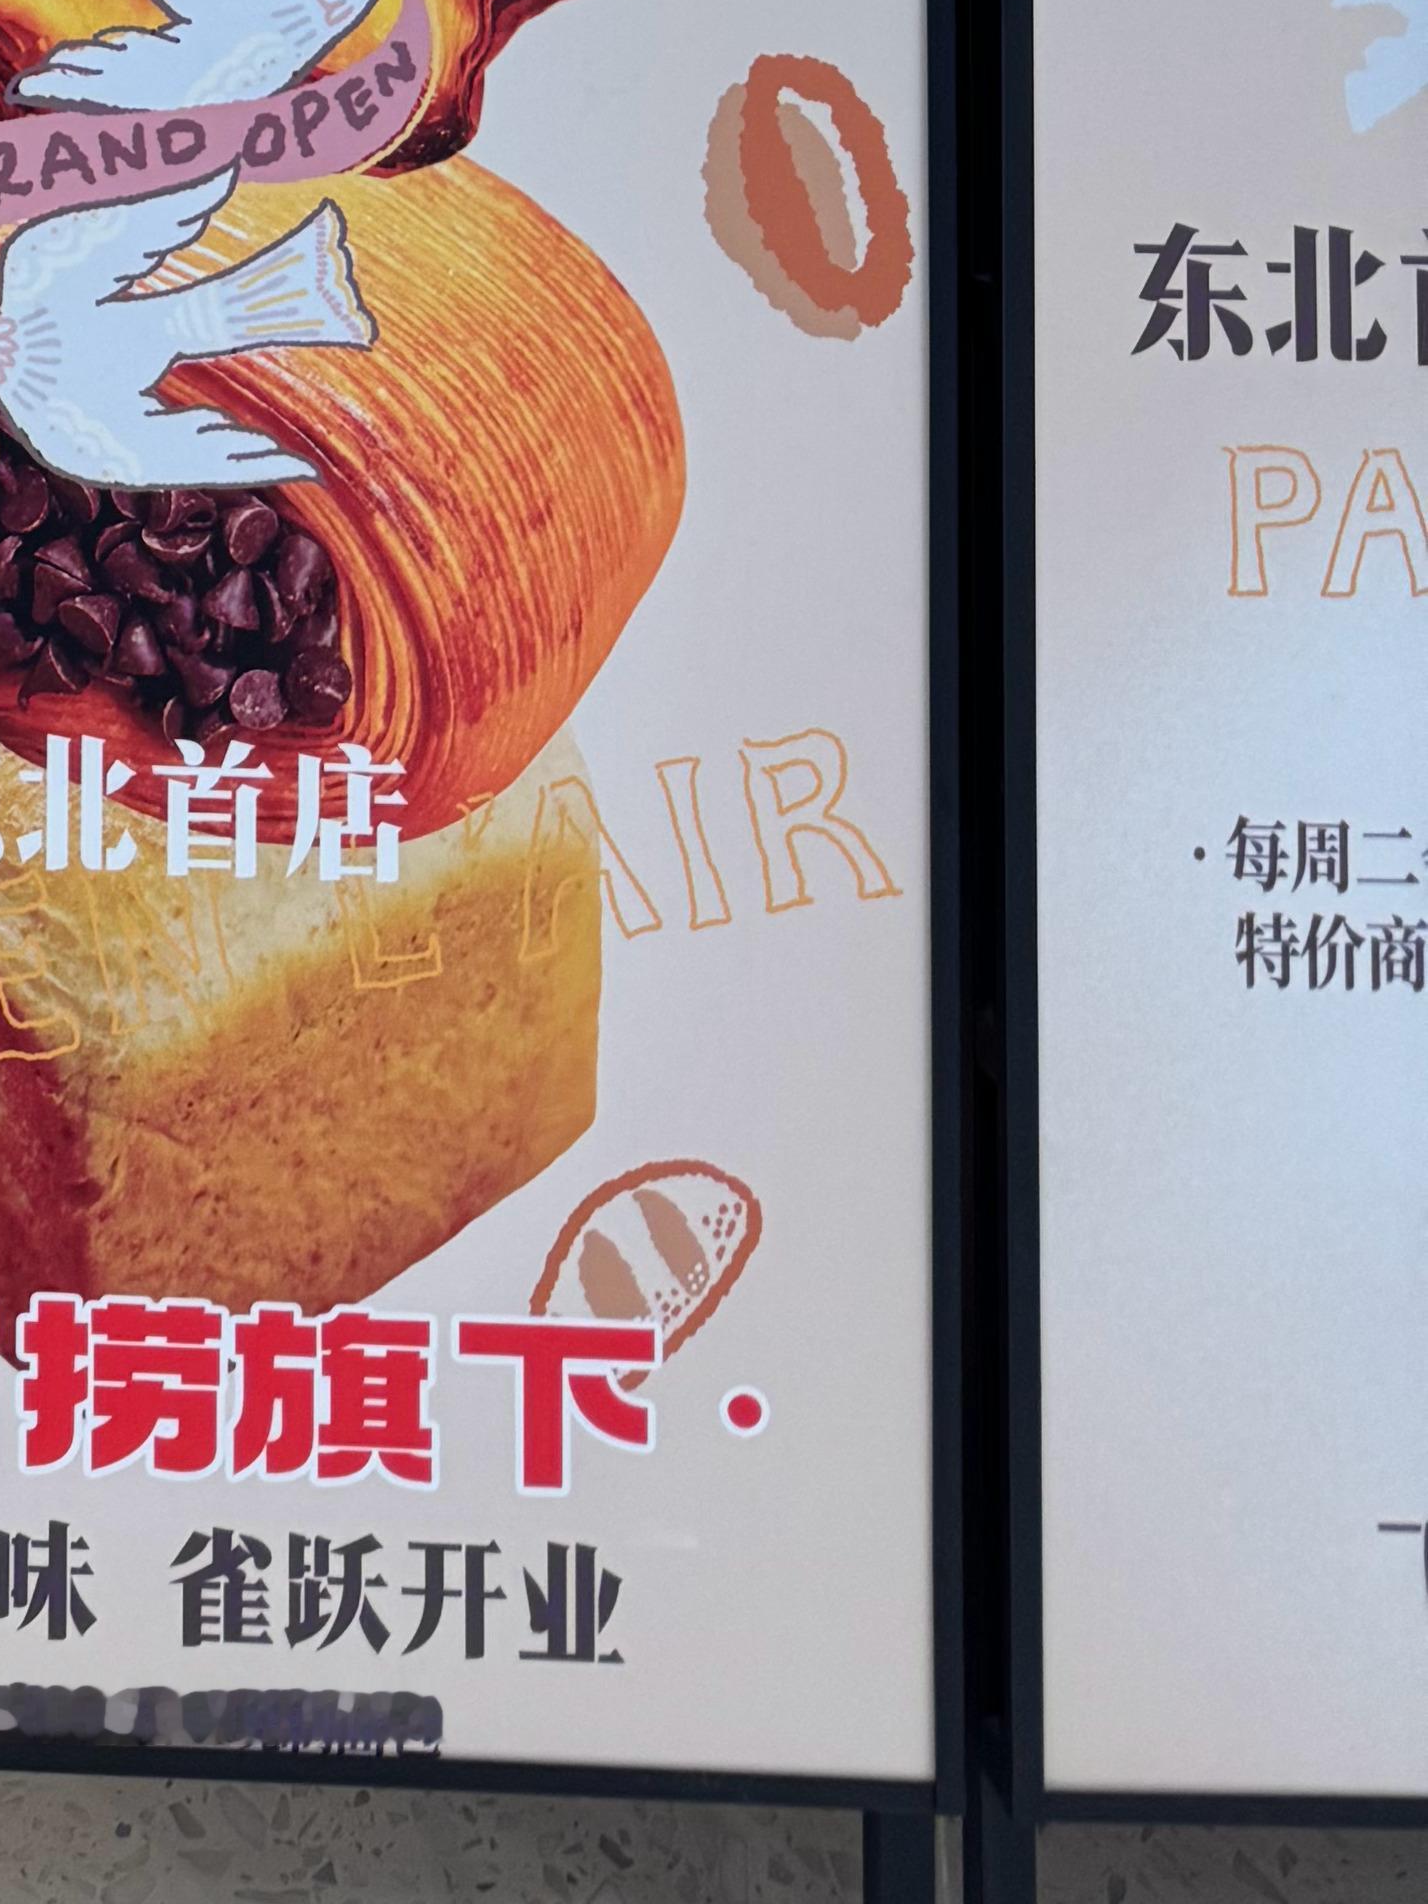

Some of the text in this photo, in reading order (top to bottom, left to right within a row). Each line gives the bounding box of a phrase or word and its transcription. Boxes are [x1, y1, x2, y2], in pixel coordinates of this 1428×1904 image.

[242, 40, 418, 169] OPEN
[167, 1526, 625, 1664] 雀跃开业
